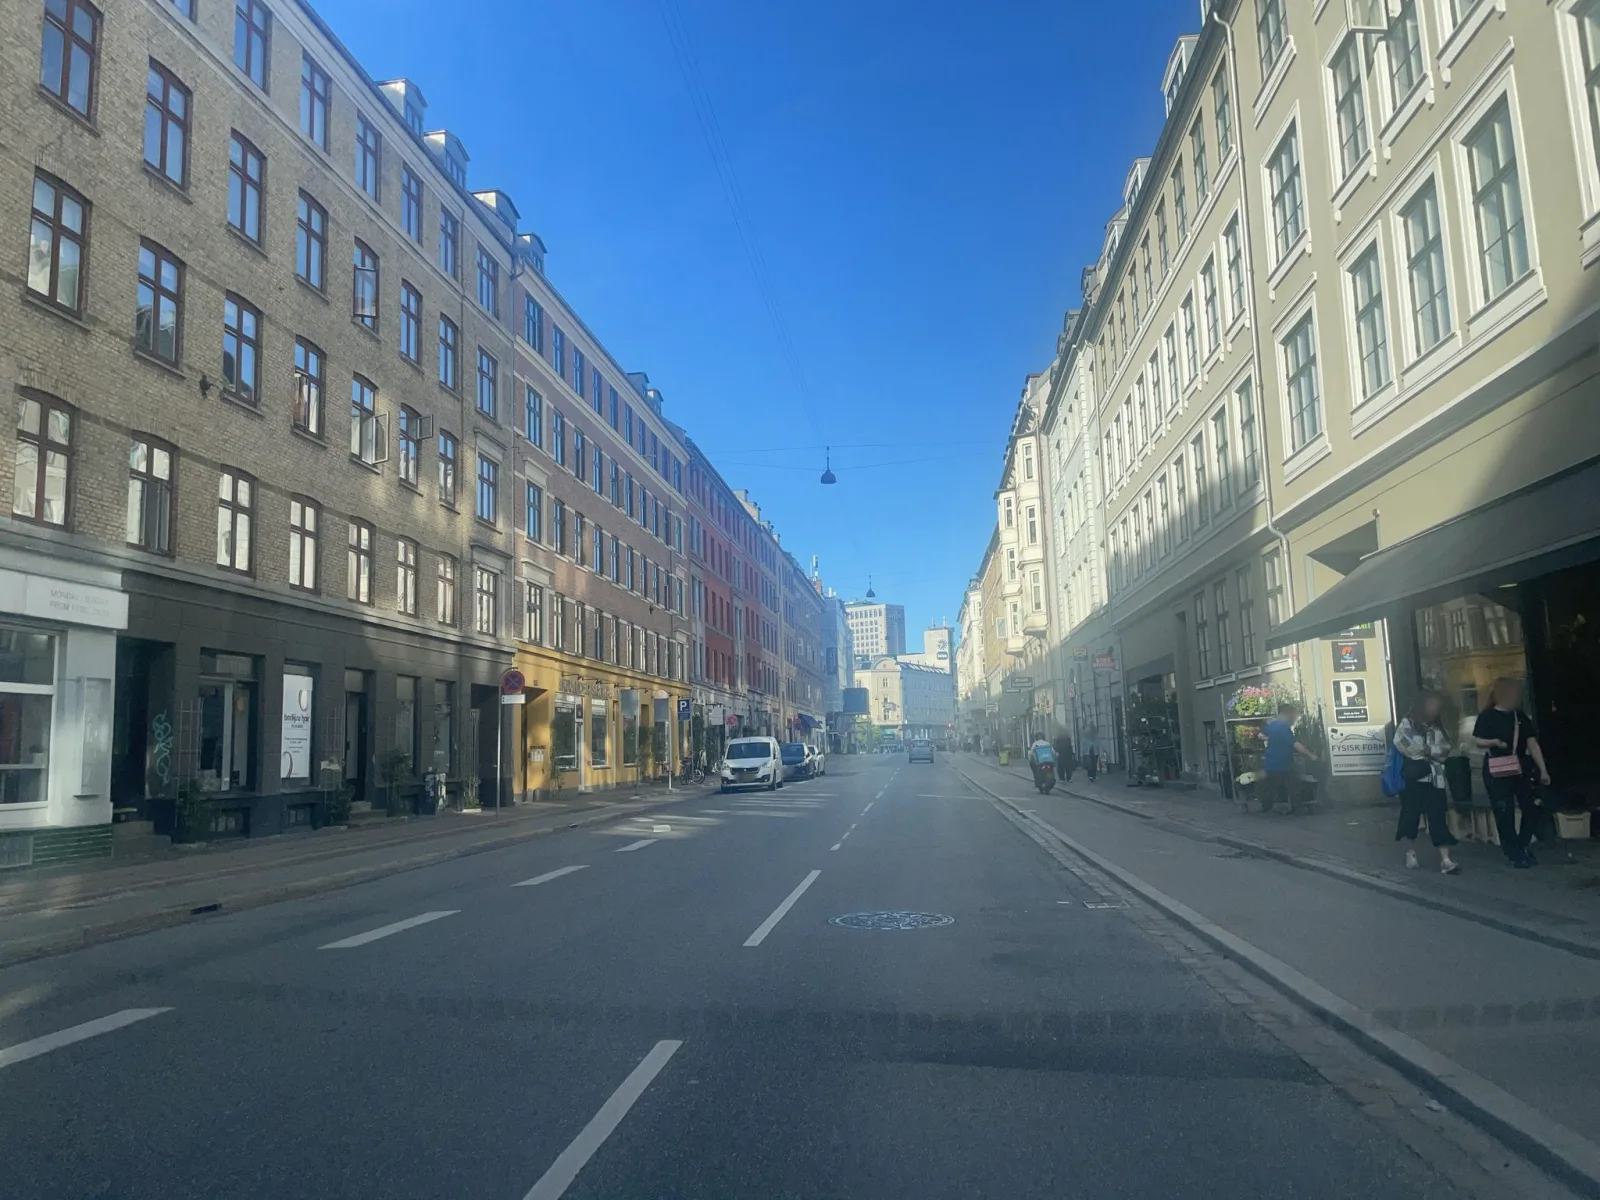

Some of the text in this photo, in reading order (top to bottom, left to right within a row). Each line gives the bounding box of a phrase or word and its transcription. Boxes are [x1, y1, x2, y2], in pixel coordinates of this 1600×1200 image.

[1339, 681, 1358, 706] P
[679, 701, 688, 711] P
[1331, 743, 1386, 752] FYSISK FORM
